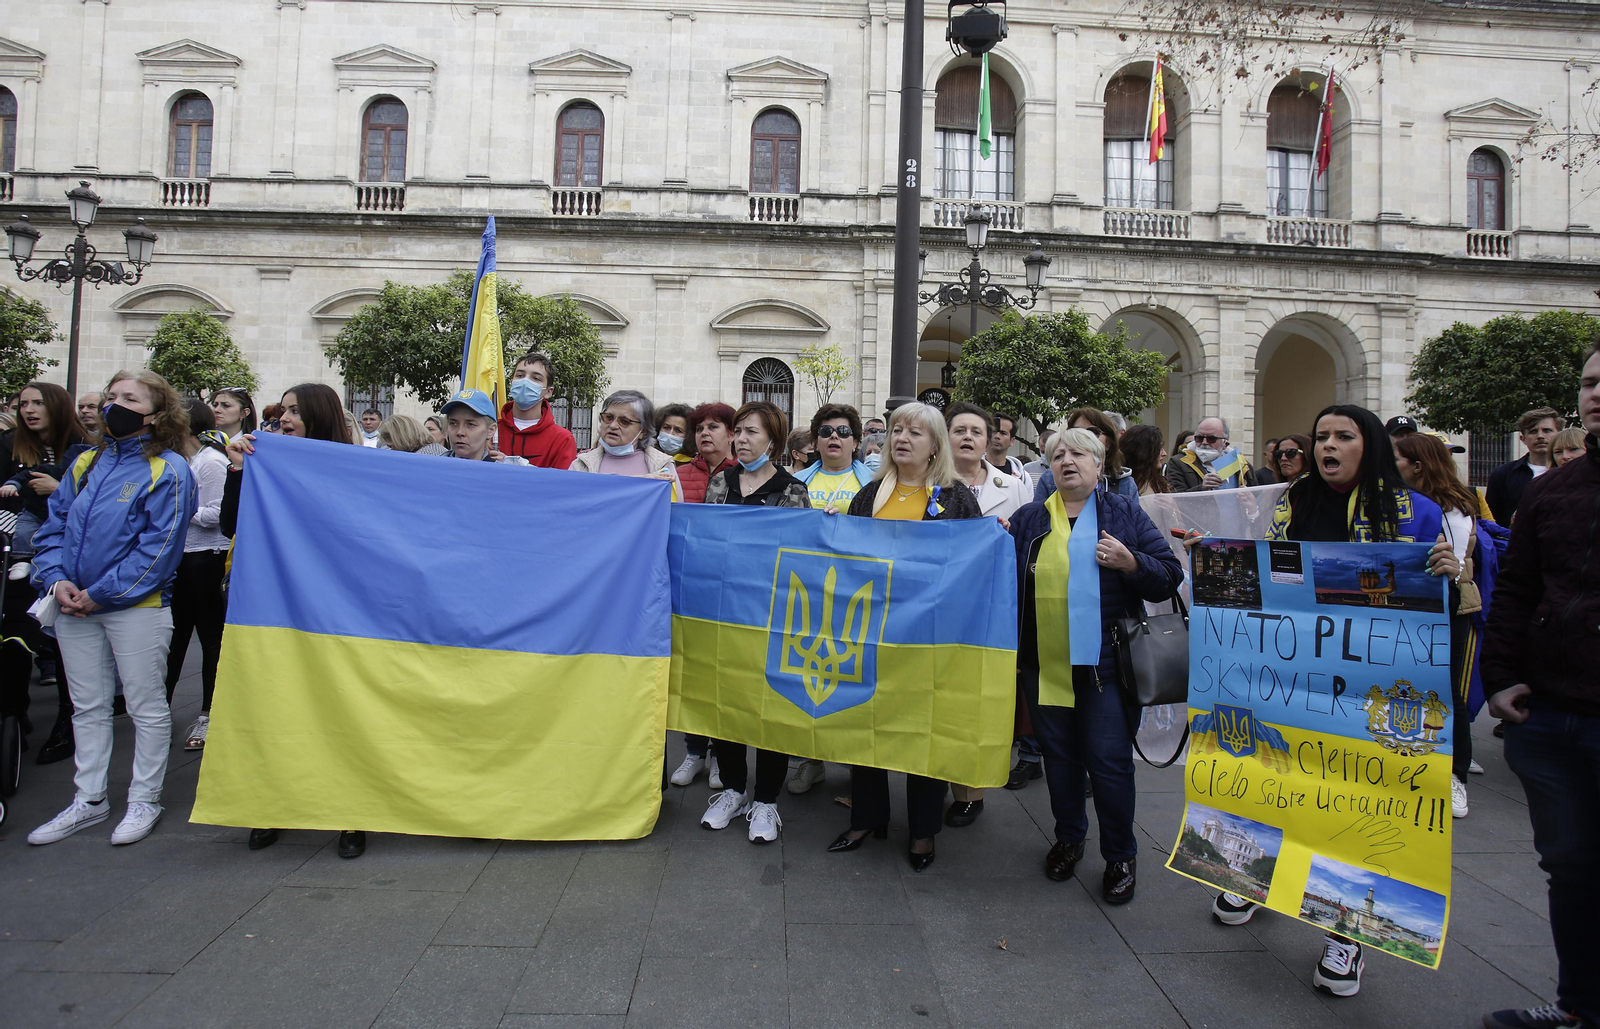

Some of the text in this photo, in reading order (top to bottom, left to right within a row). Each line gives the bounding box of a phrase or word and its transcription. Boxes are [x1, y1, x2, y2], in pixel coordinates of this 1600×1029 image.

[905, 158, 917, 188] 28
[1204, 608, 1450, 667] NATO PLEASE
[1191, 759, 1249, 799] Cielo
[1297, 740, 1389, 788] Cierra
